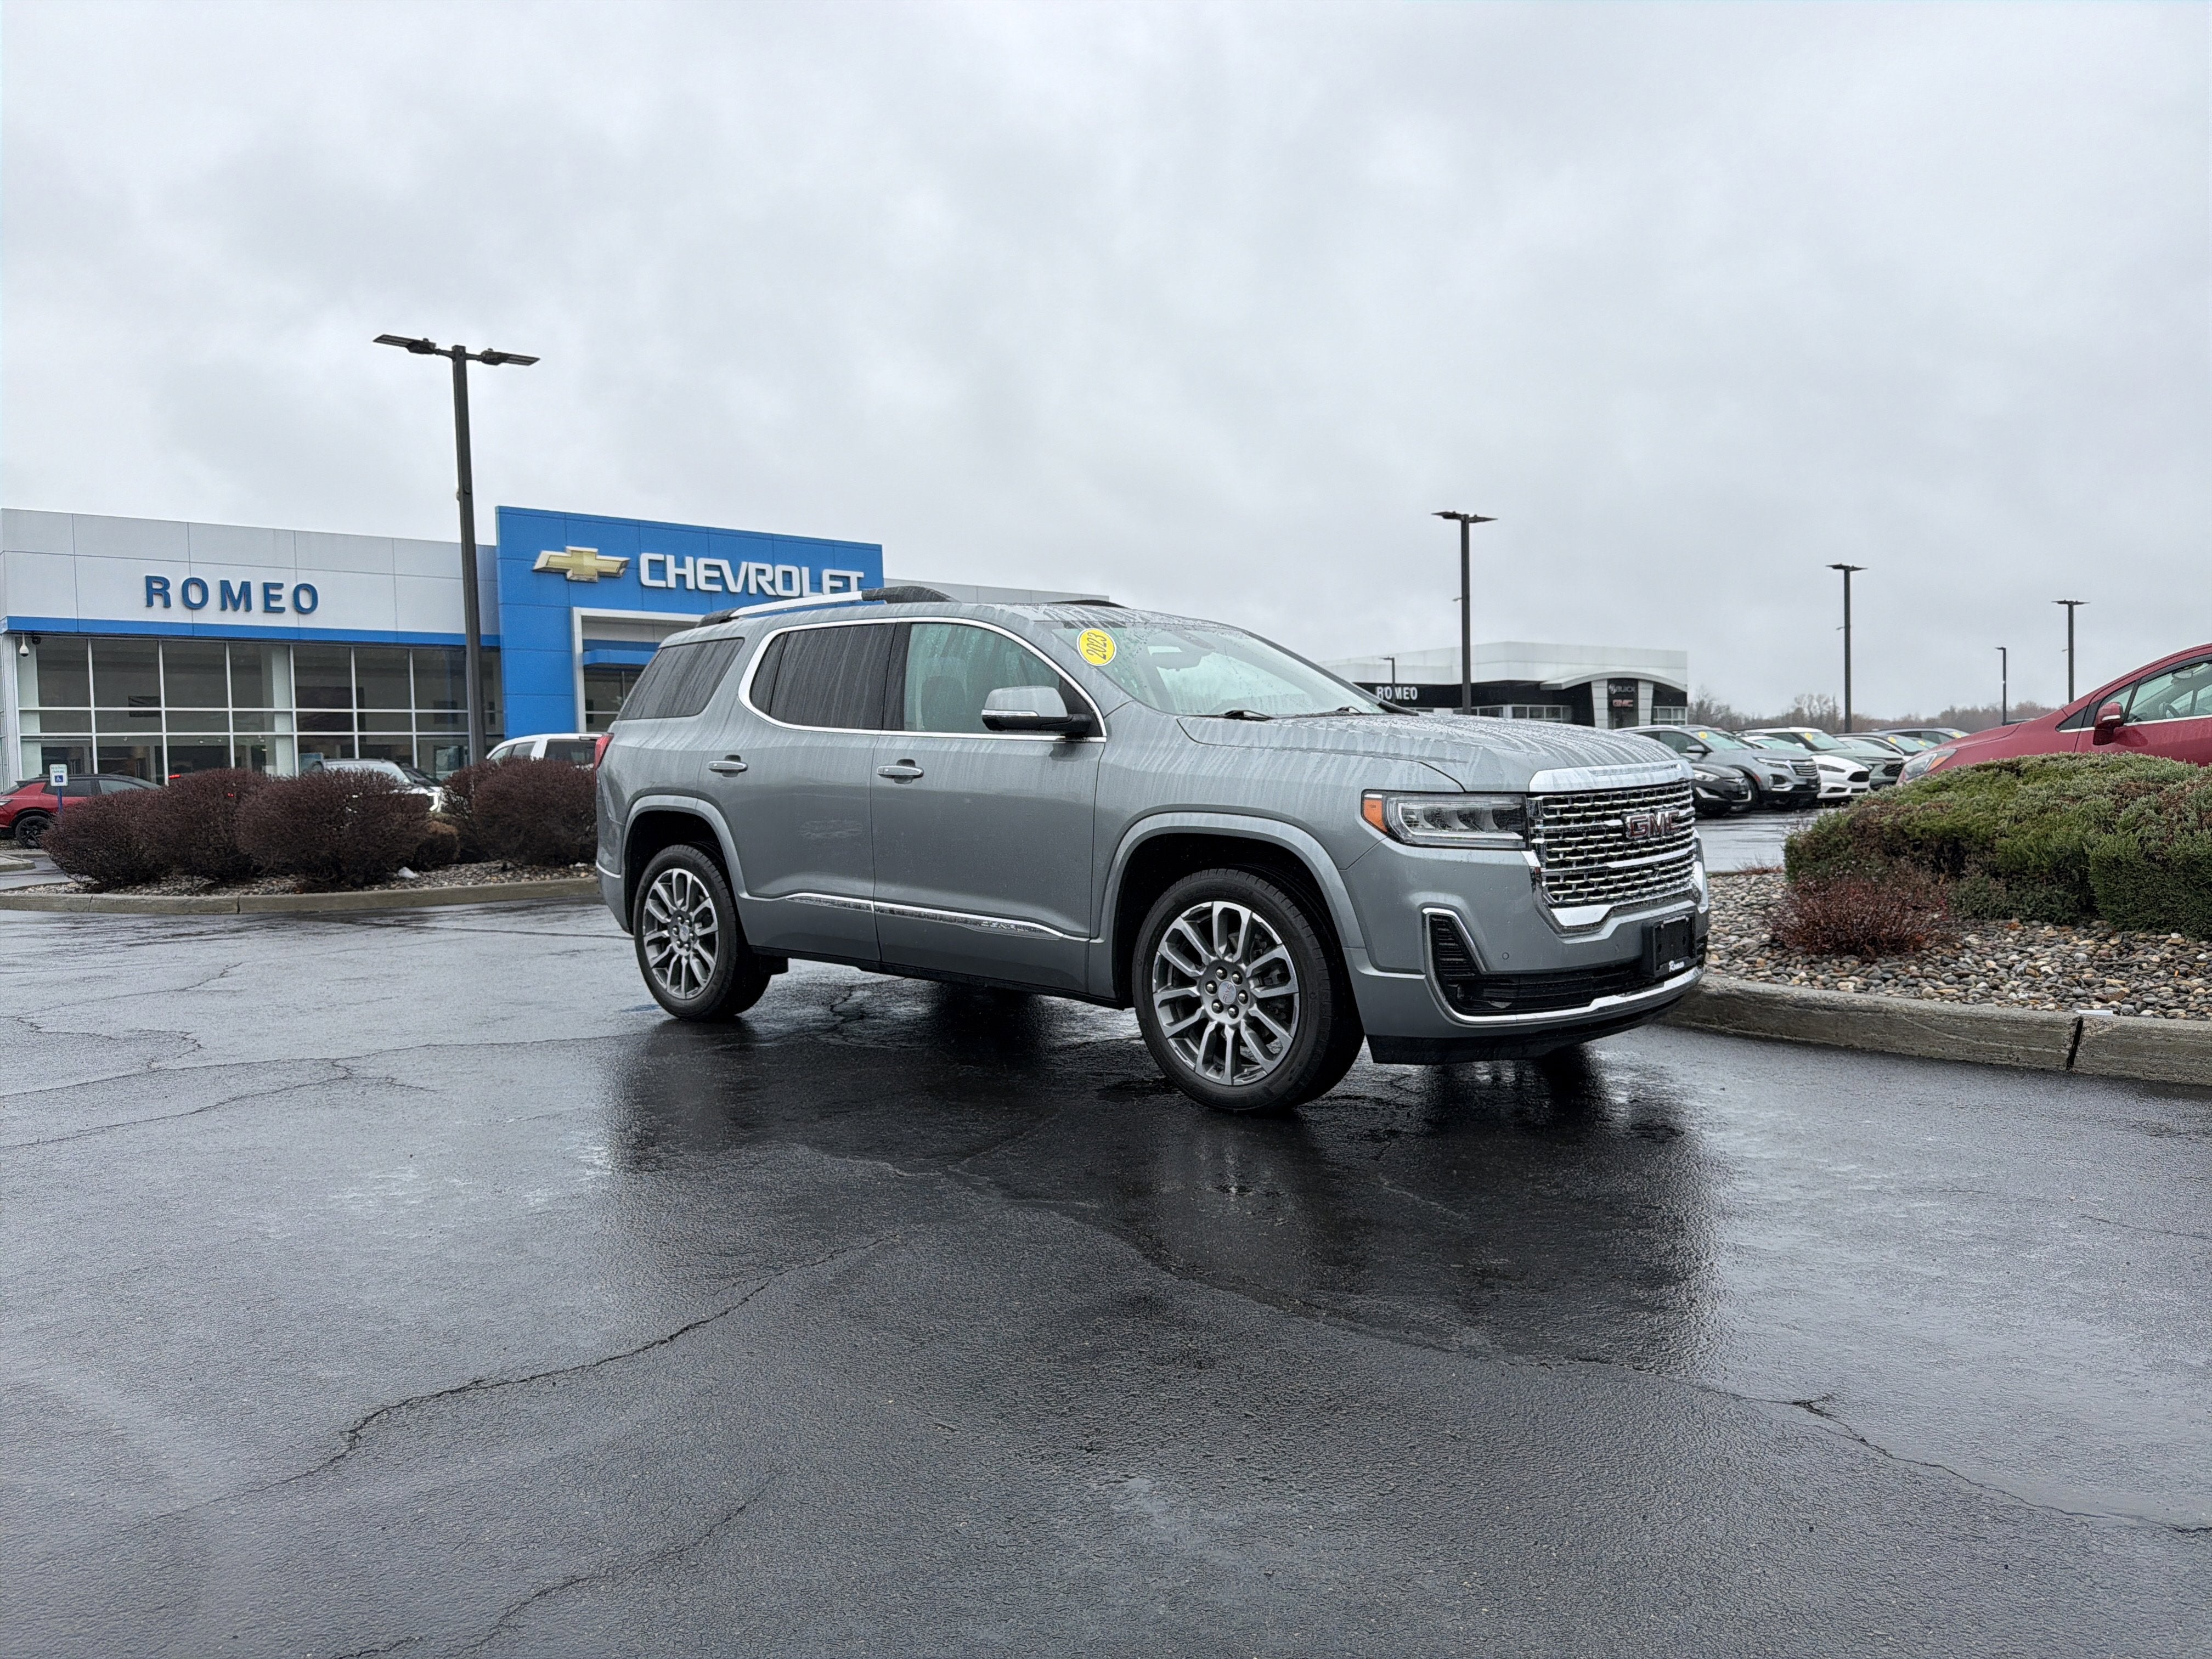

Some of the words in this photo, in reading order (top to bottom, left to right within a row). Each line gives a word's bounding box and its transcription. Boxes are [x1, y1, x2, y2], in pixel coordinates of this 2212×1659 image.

[640, 552, 865, 597] CHEVROLET
[145, 575, 319, 614] ROMEO
[1086, 632, 1107, 660] 2023
[1376, 686, 1418, 700] ROMEO
[1626, 811, 1680, 839] GMC
